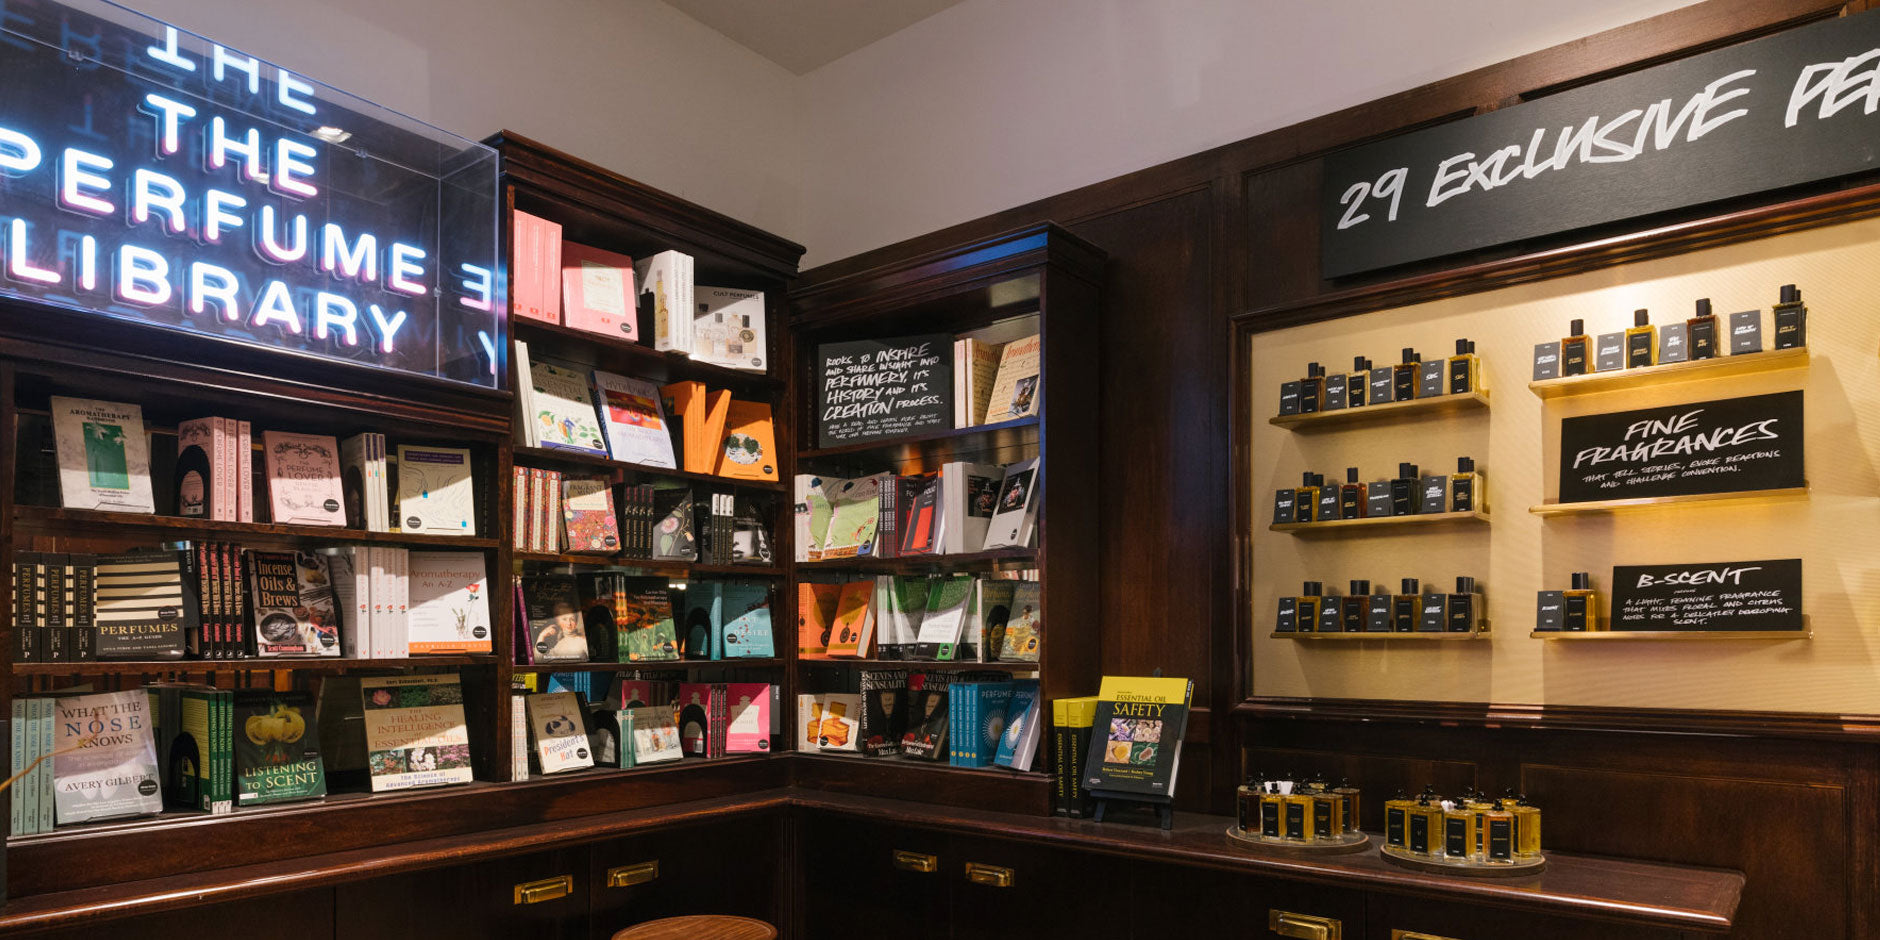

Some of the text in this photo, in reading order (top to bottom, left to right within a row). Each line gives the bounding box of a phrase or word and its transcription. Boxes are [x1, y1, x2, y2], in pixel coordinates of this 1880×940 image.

[144, 92, 318, 198] THE
[1337, 167, 1409, 231] 29
[1425, 68, 1757, 209] EXCLUSIVE
[10, 217, 408, 355] LIBRARY
[825, 342, 931, 368] BOOKS TO INSPIRE
[825, 367, 844, 377] AND
[846, 363, 876, 374] SHARE
[920, 355, 940, 366] INTO
[825, 370, 908, 392] PERFUMERY,
[826, 387, 885, 405] HISTORY
[885, 386, 905, 396] AND
[70, 408, 131, 420] AROMATHERAPY
[823, 395, 943, 421] CREATION PROCESS.
[1624, 408, 1706, 442] FINE
[1572, 418, 1780, 469] FRAGRANCES
[286, 464, 324, 473] PERFUME
[1582, 449, 1781, 484] THAT TELL STORIES, EVOKE REACTIONS
[1599, 464, 1742, 489] AND CHALLENGE CONVENTION.
[409, 568, 481, 581] Aromatherapy
[1636, 566, 1763, 589] B-SCENT
[260, 576, 295, 591] Oils &
[422, 580, 434, 588] An
[261, 591, 298, 607] Brews
[1625, 598, 1632, 606] A
[1719, 589, 1782, 600] FRAGRANCE
[1681, 603, 1718, 611] FLORAL
[1722, 600, 1744, 608] AND
[100, 623, 178, 636] PERFUMES
[1672, 617, 1708, 626] SCENT.
[866, 679, 907, 691] SENSUALITY
[981, 690, 1013, 698] PERFUME
[1116, 694, 1167, 703] ESSENTIAL OIL
[61, 701, 142, 719] WHAT THE
[1112, 702, 1167, 717] SAFETY
[64, 715, 142, 737] NOSE
[391, 713, 442, 724] HEALING
[378, 721, 456, 734] INTELLIGENCE
[76, 733, 133, 749] KNOWS
[375, 736, 436, 749] ESSENTIAL
[244, 761, 317, 778] LISTENING
[65, 780, 103, 792] AVERY
[245, 772, 318, 791] TO SCENT
